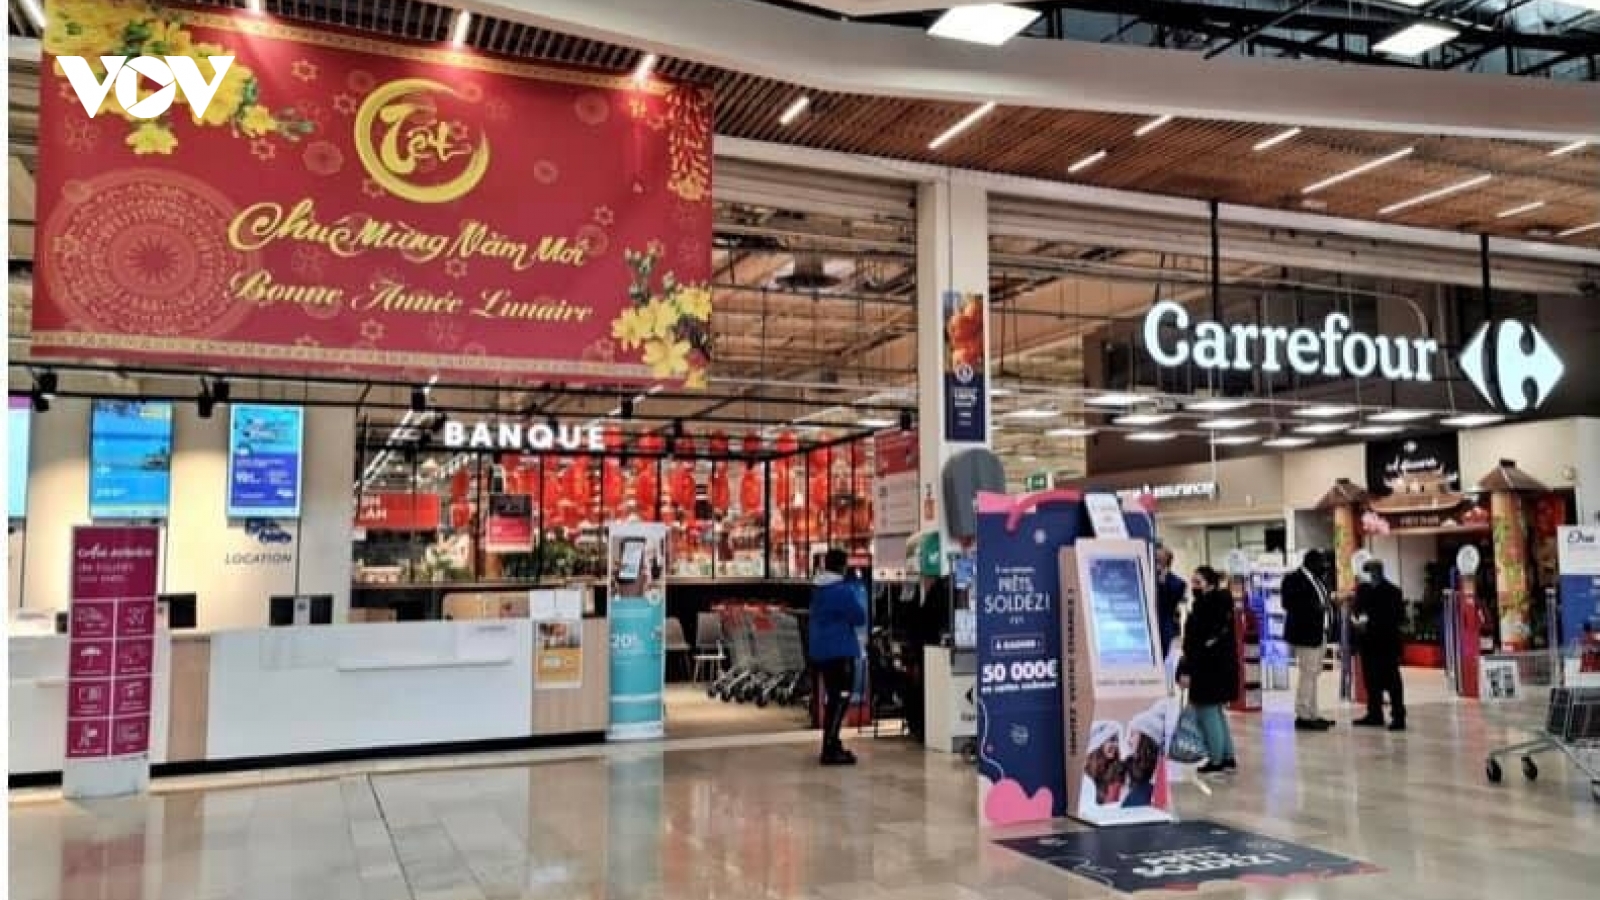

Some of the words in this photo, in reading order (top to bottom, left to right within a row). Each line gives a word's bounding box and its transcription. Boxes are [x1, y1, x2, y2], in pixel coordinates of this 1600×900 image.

[224, 269, 344, 307] Bonne
[469, 290, 593, 322] Lunaire
[1143, 300, 1438, 382] Carrefour
[444, 421, 605, 449] BANQUE
[225, 552, 292, 566] LOCATION
[982, 662, 1006, 683] 50
